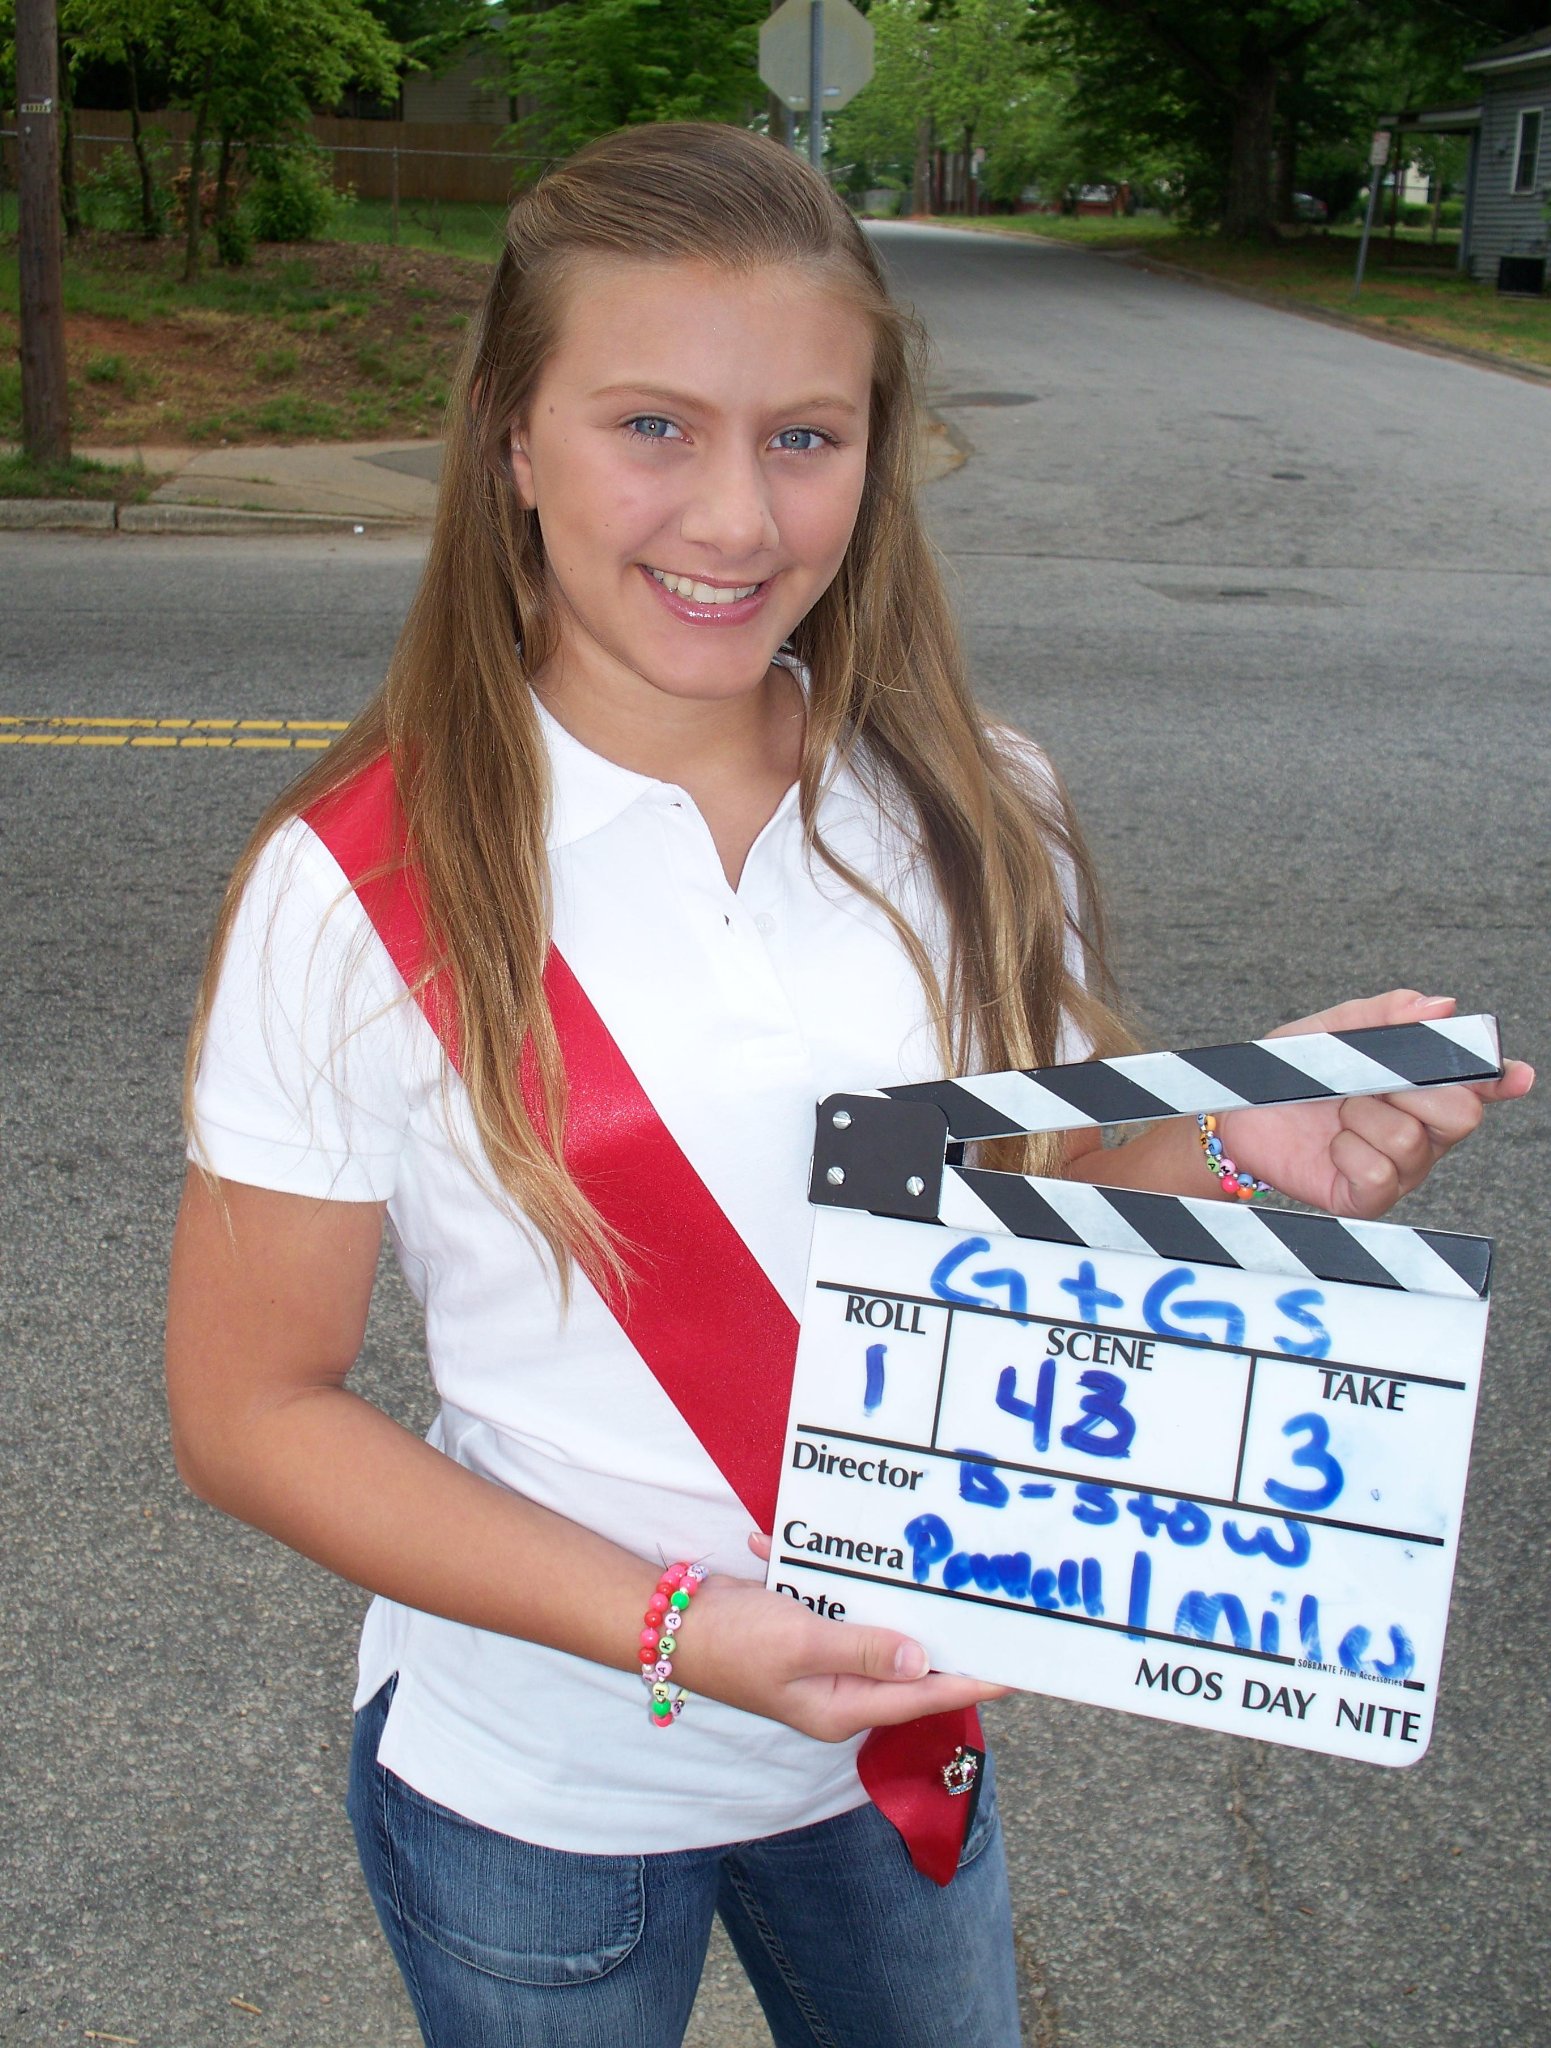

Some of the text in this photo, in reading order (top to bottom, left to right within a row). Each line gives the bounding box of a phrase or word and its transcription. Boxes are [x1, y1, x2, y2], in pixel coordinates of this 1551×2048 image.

[844, 1294, 926, 1335] ROLL
[1045, 1327, 1156, 1371] SCENE
[1318, 1368, 1407, 1411] TAKE
[791, 1440, 924, 1491] Director
[1263, 1412, 1345, 1512] 3
[782, 1519, 905, 1570] Camera
[1297, 1658, 1403, 1687] SOBRANTE Film Accessories
[1134, 1657, 1422, 1744] MOS DAY NITE
